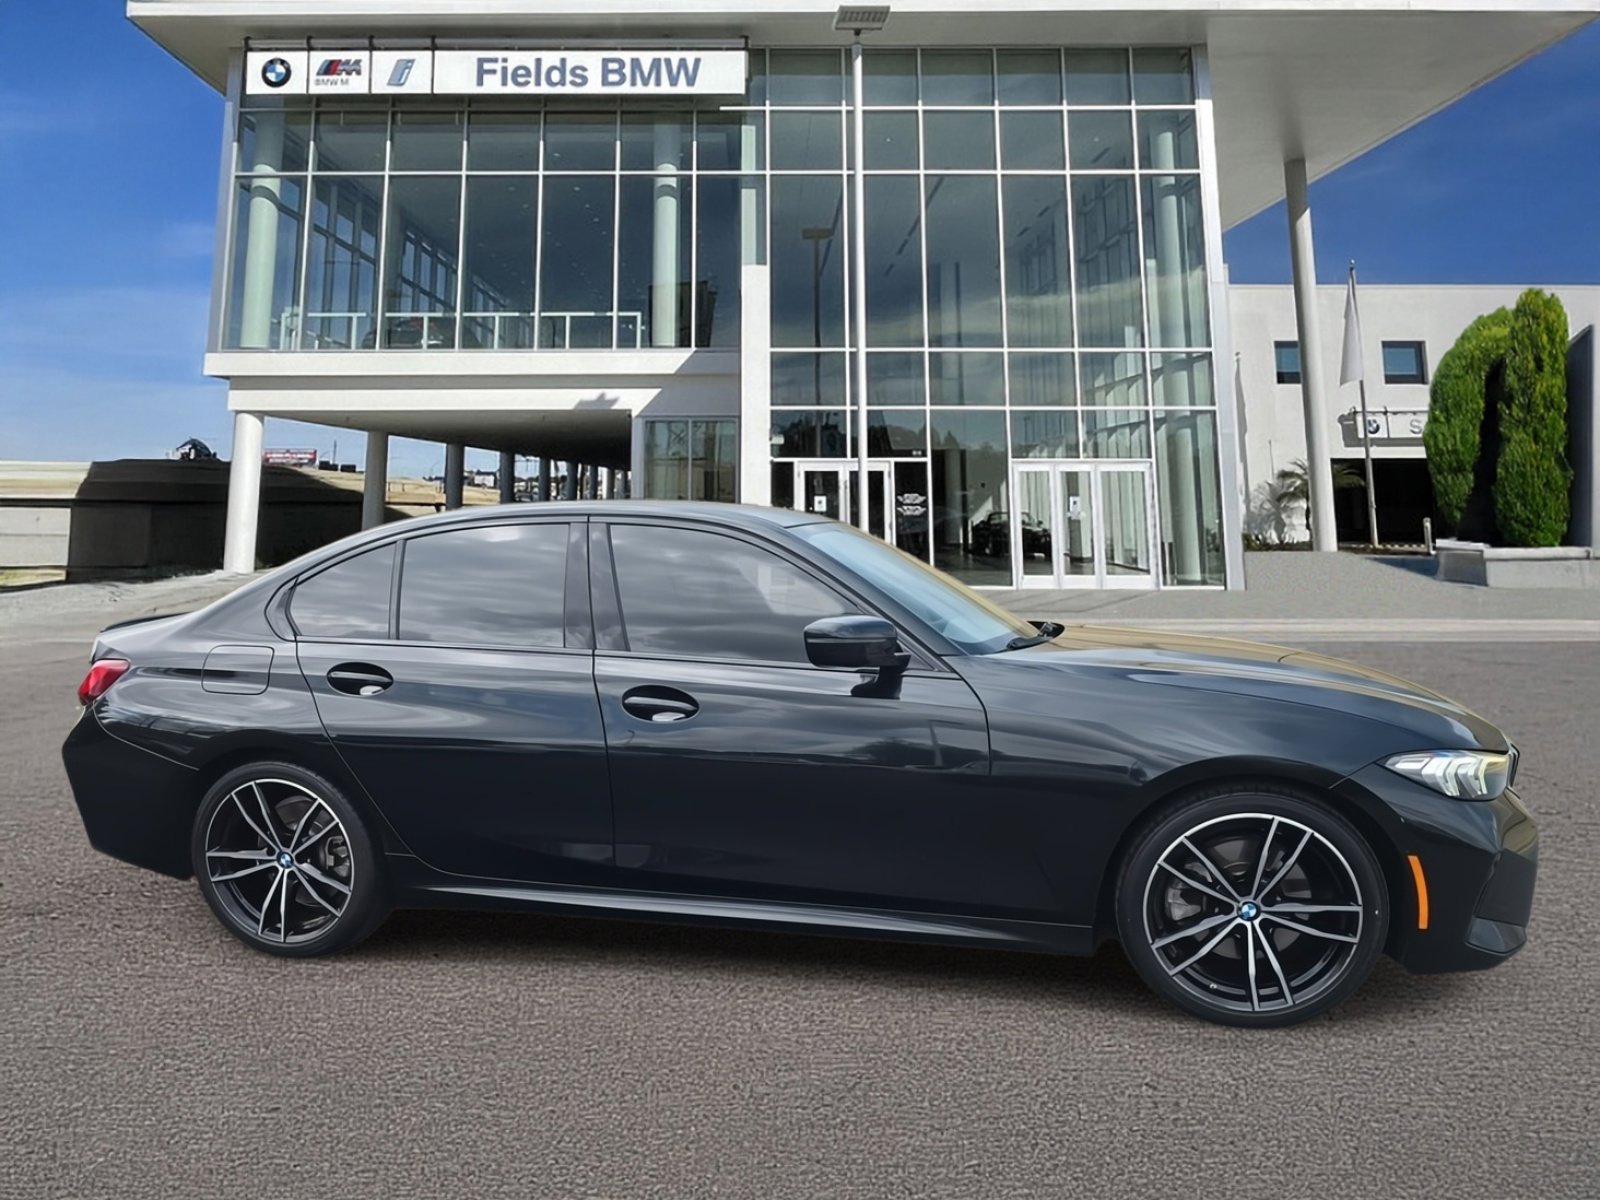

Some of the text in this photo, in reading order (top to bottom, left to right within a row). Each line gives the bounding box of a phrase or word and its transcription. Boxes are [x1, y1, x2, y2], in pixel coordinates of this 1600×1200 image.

[476, 57, 701, 87] Fields BMW
[1409, 419, 1423, 435] S
